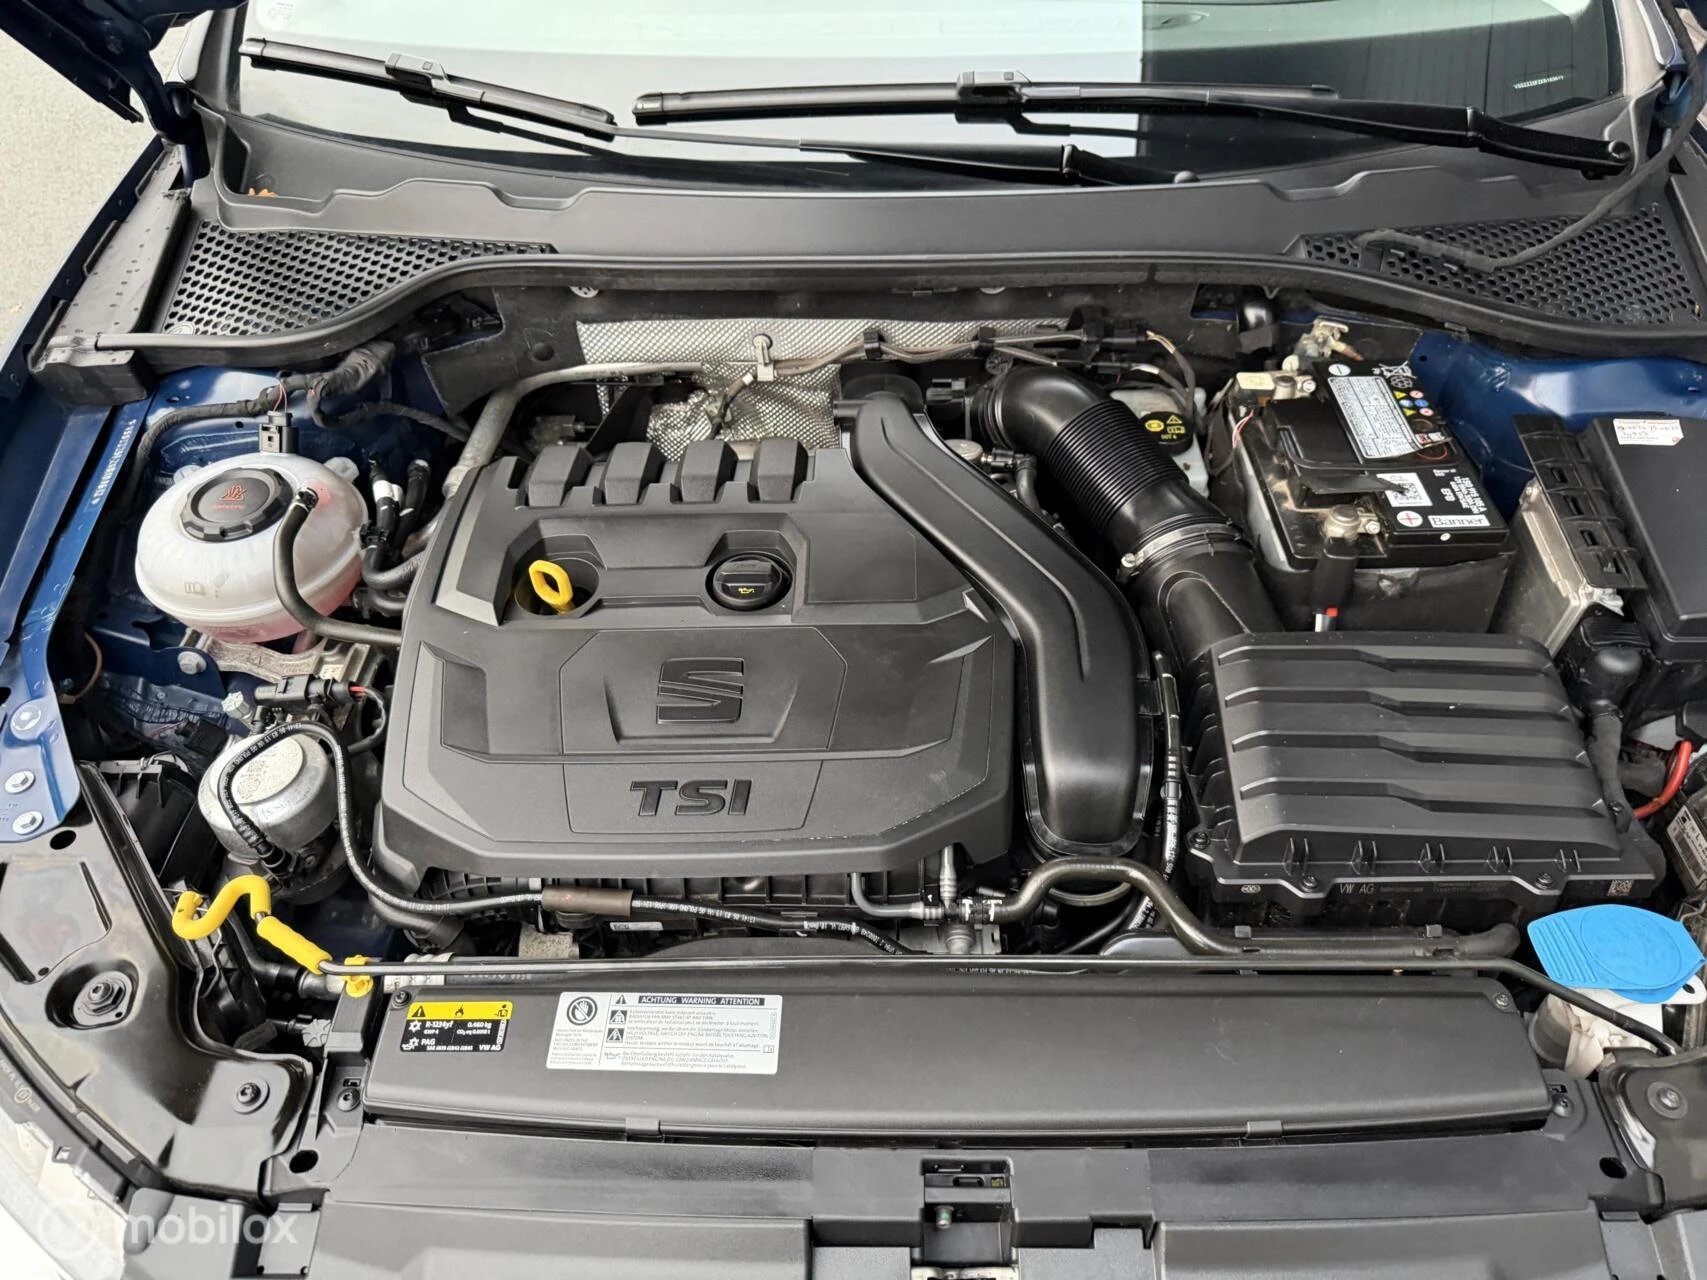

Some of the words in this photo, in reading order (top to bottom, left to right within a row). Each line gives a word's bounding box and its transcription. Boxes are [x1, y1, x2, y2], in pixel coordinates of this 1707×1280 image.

[1432, 517, 1484, 526] Banner
[630, 779, 752, 816] TSI
[1339, 883, 1354, 894] VW
[1359, 883, 1374, 894] AG
[720, 998, 760, 1006] ATTENTION
[426, 1021, 454, 1029] R-1234yf
[484, 1021, 492, 1029] kg
